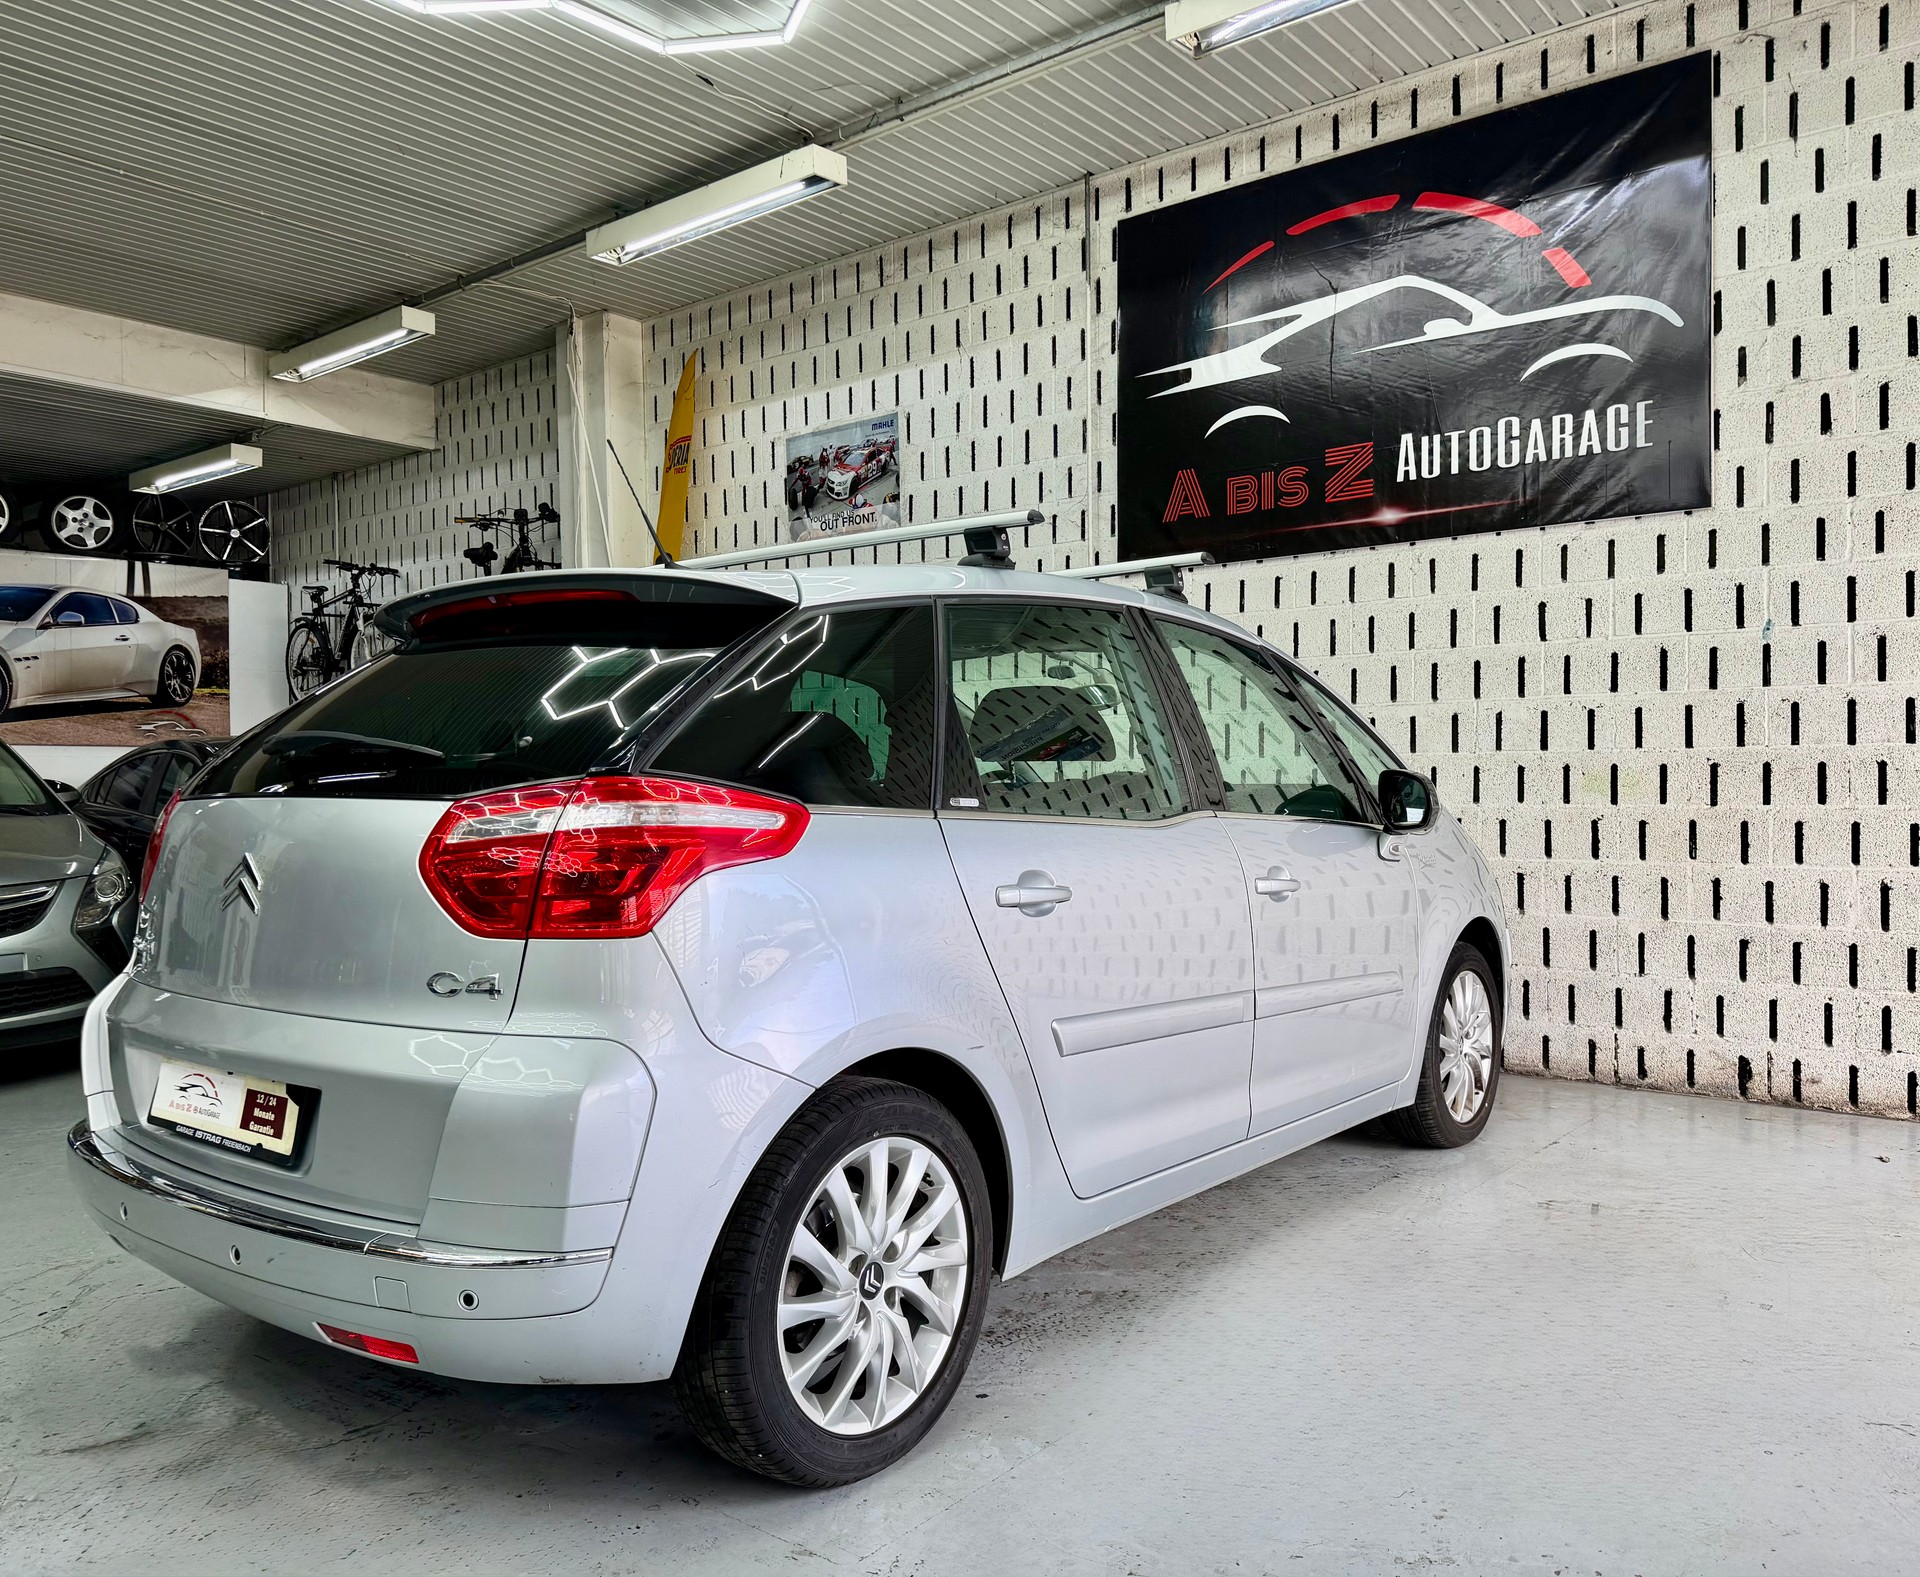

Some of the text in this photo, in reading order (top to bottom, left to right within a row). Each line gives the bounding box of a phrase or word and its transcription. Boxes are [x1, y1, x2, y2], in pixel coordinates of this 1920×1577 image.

[871, 419, 894, 431] MAHLE
[867, 460, 878, 479] 29
[1162, 468, 1211, 523] A
[1227, 466, 1309, 516] BIS
[1325, 442, 1374, 503] Z
[820, 511, 878, 531] OUT FRONT.
[426, 971, 504, 1001] C4
[168, 1100, 175, 1109] A
[185, 1103, 193, 1113] Z
[256, 1093, 265, 1104] 12
[268, 1096, 277, 1107] 24
[253, 1107, 275, 1121] Monate
[176, 1125, 196, 1136] GARAGE
[249, 1121, 275, 1136] Garantie
